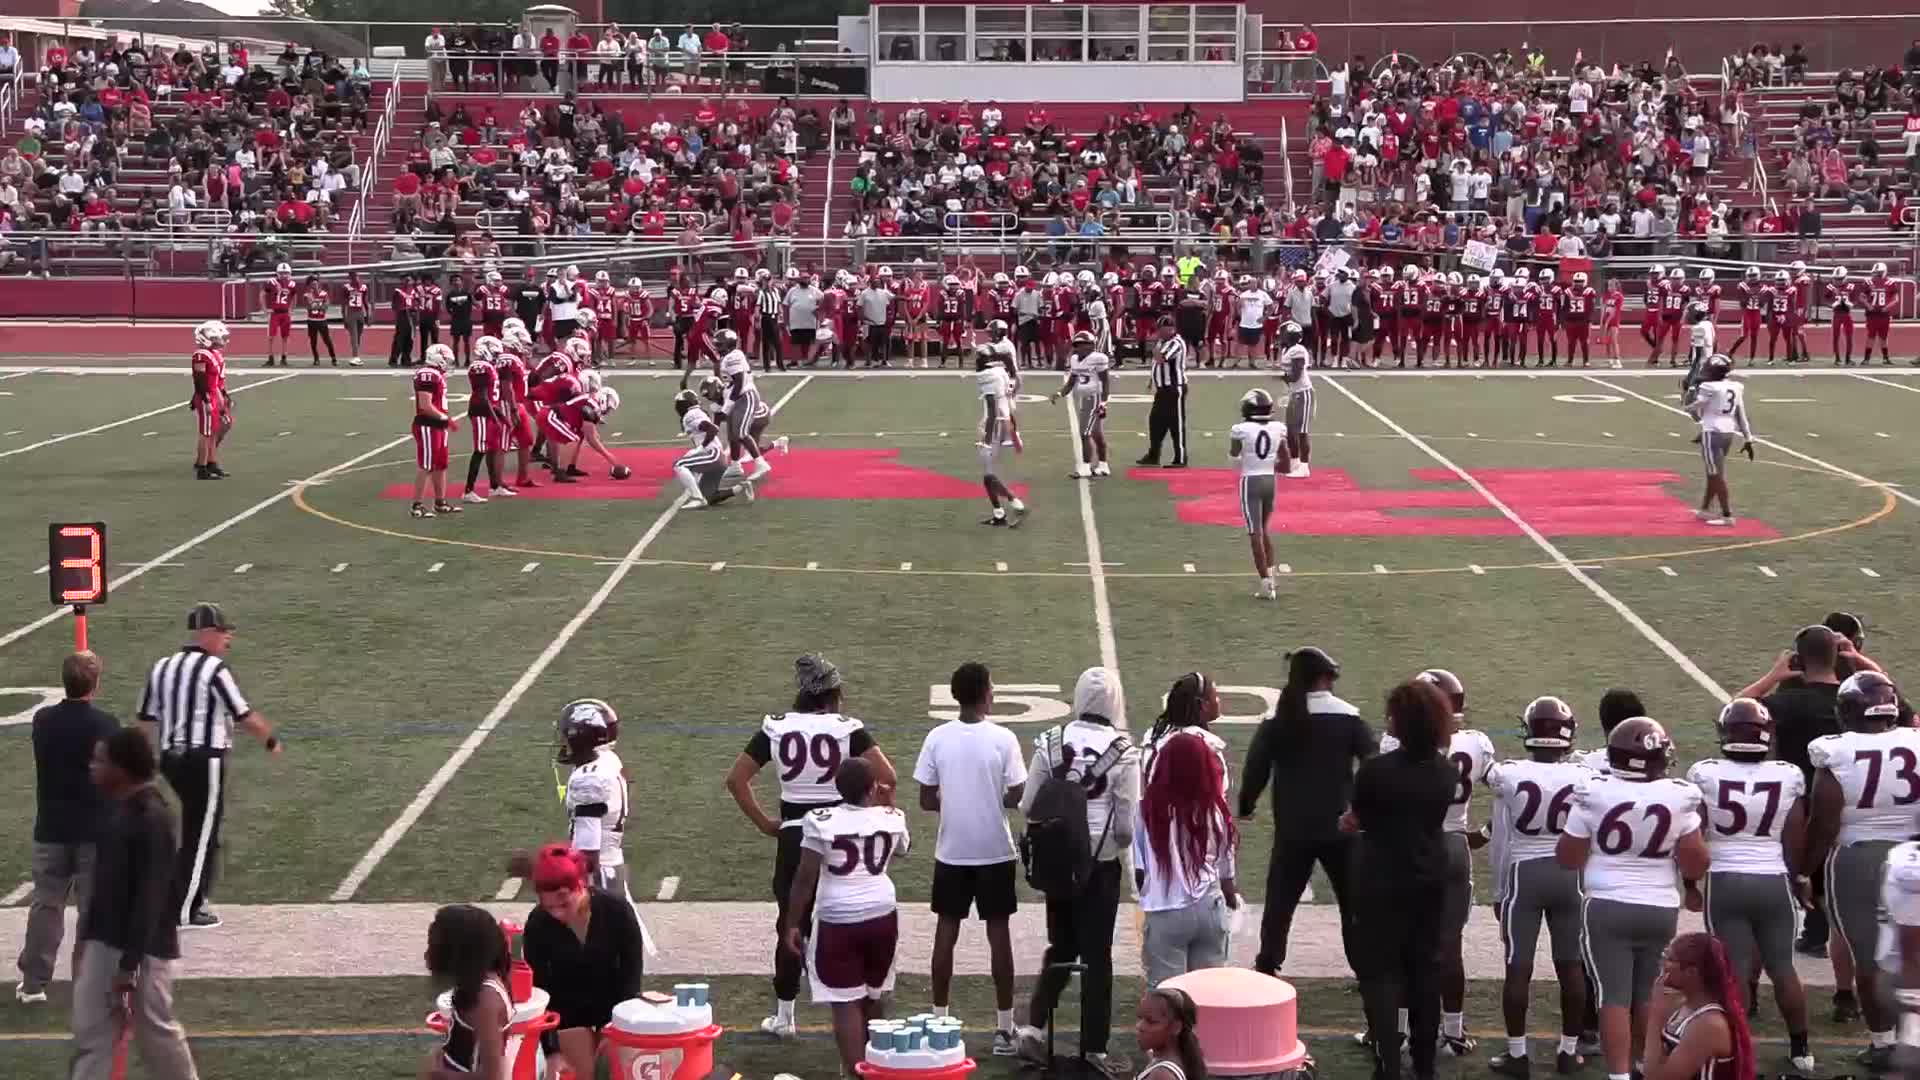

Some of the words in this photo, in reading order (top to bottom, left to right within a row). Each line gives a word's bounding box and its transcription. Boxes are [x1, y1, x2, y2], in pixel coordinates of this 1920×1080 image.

[487, 297, 501, 311] 65
[1773, 298, 1788, 312] 53
[1871, 292, 1886, 306] 78
[1722, 389, 1736, 414] 3
[1255, 430, 1271, 460] 0
[60, 527, 101, 600] 3
[779, 731, 842, 785] 99
[1855, 747, 1920, 809] 73
[1513, 780, 1576, 836] 26
[1596, 801, 1673, 858] 62
[1716, 780, 1783, 838] 57
[828, 830, 893, 876] 50
